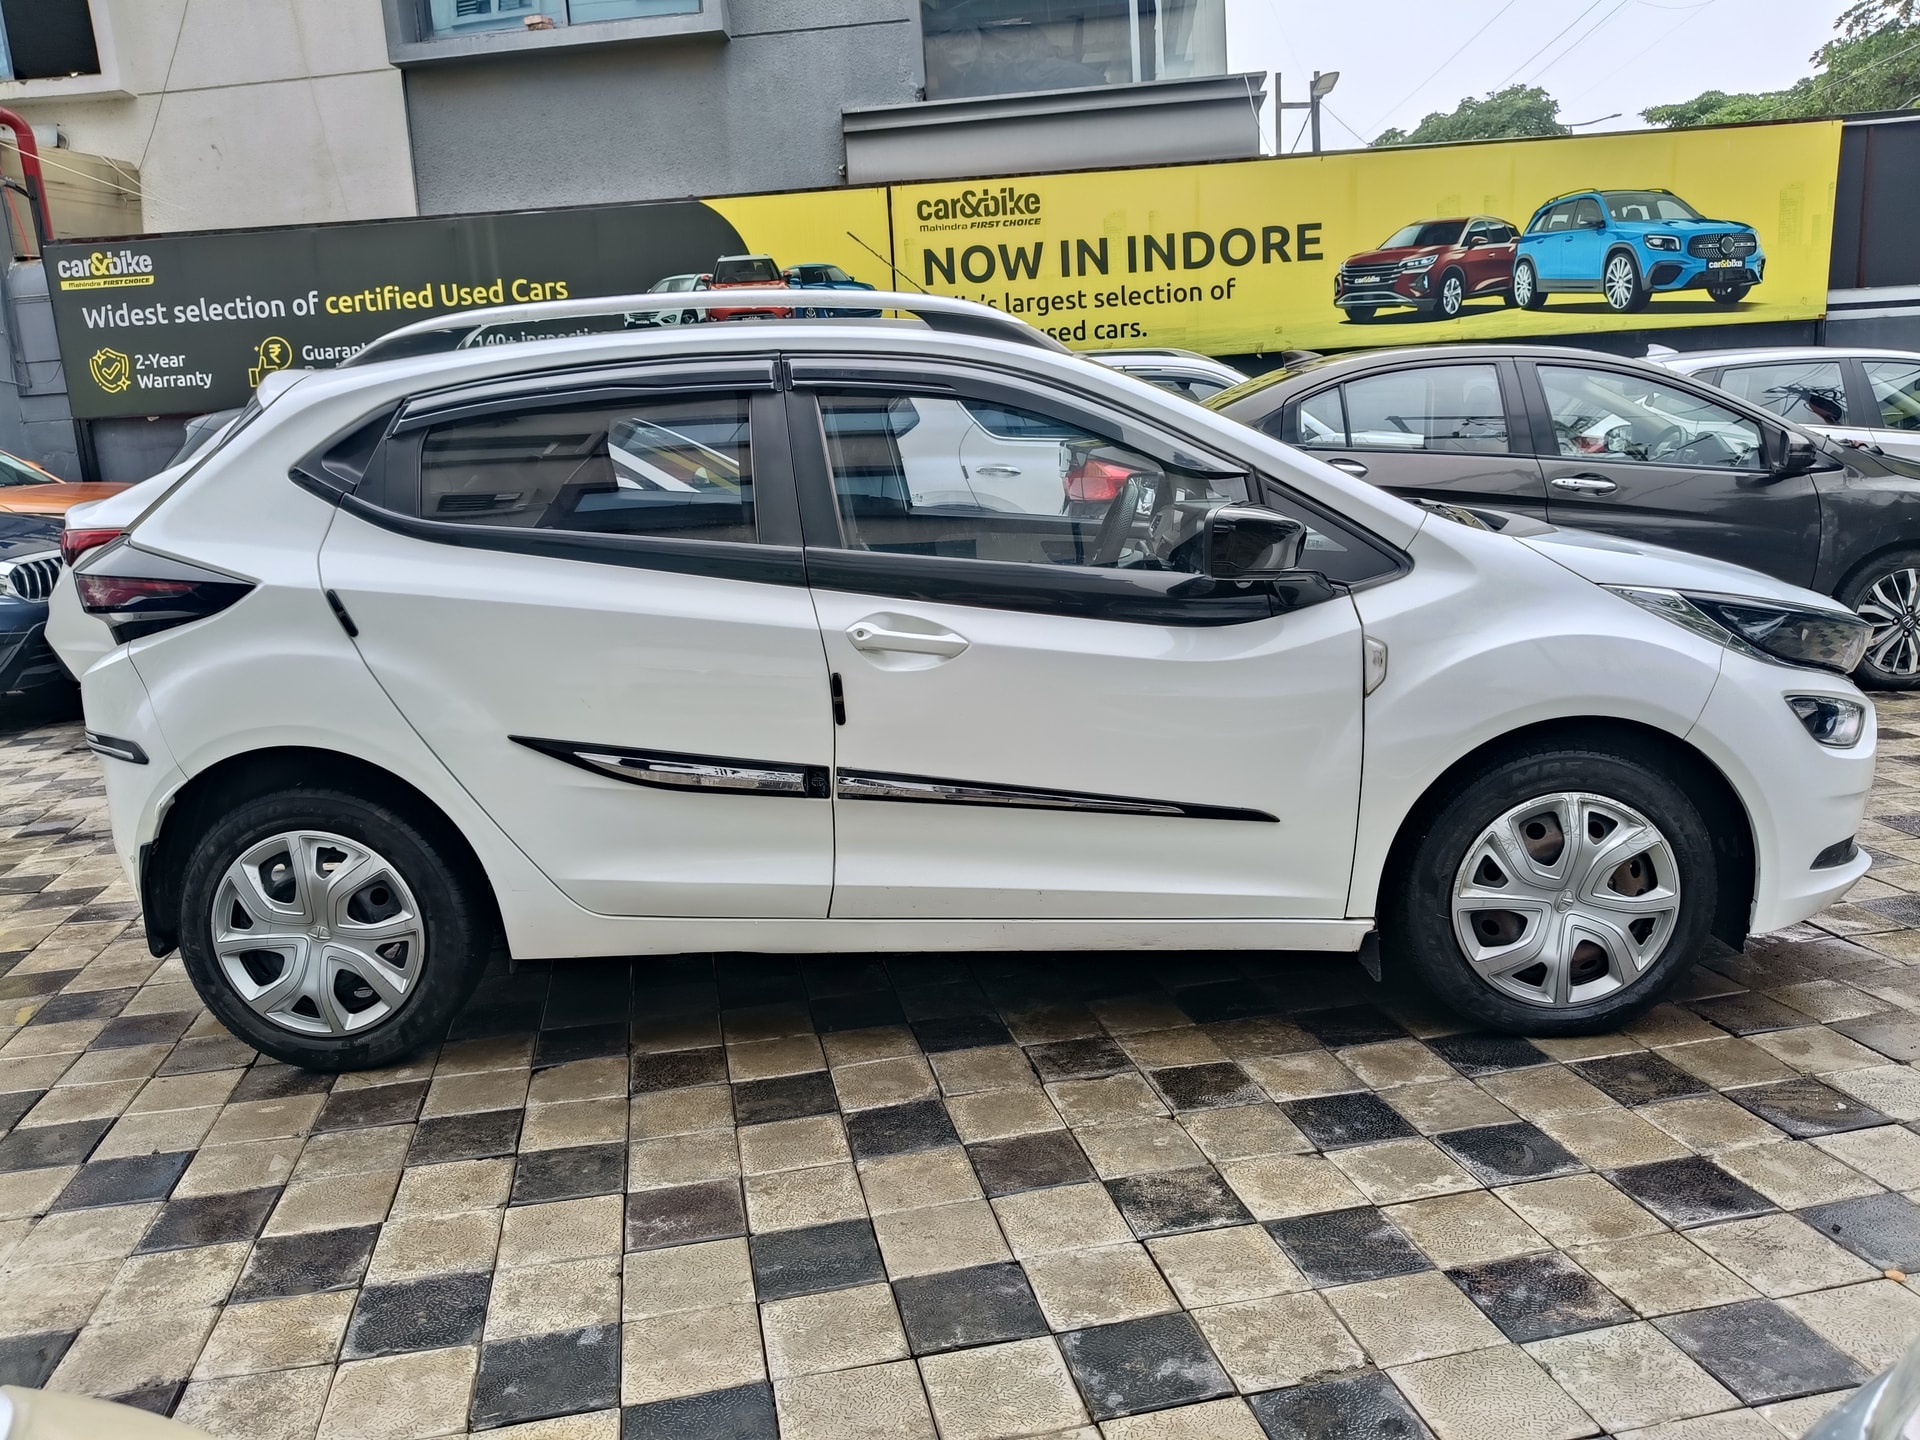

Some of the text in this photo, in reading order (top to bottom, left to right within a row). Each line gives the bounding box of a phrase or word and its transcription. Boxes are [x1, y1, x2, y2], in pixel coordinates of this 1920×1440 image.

[916, 187, 1041, 221] car&bike
[919, 218, 1042, 232] Mahindra FIRST CHOICE
[57, 250, 153, 278] car&bike
[923, 222, 1324, 286] NOW IN INDORE
[124, 277, 150, 285] CHOICE
[82, 278, 569, 329] Widest selection of certified Used Cars
[1005, 292, 1087, 316] largest
[1094, 282, 1202, 308] selection
[1210, 277, 1236, 301] of
[1039, 319, 1147, 342] sed cars.
[134, 353, 186, 370] 2-Year
[137, 371, 213, 389] Warranty
